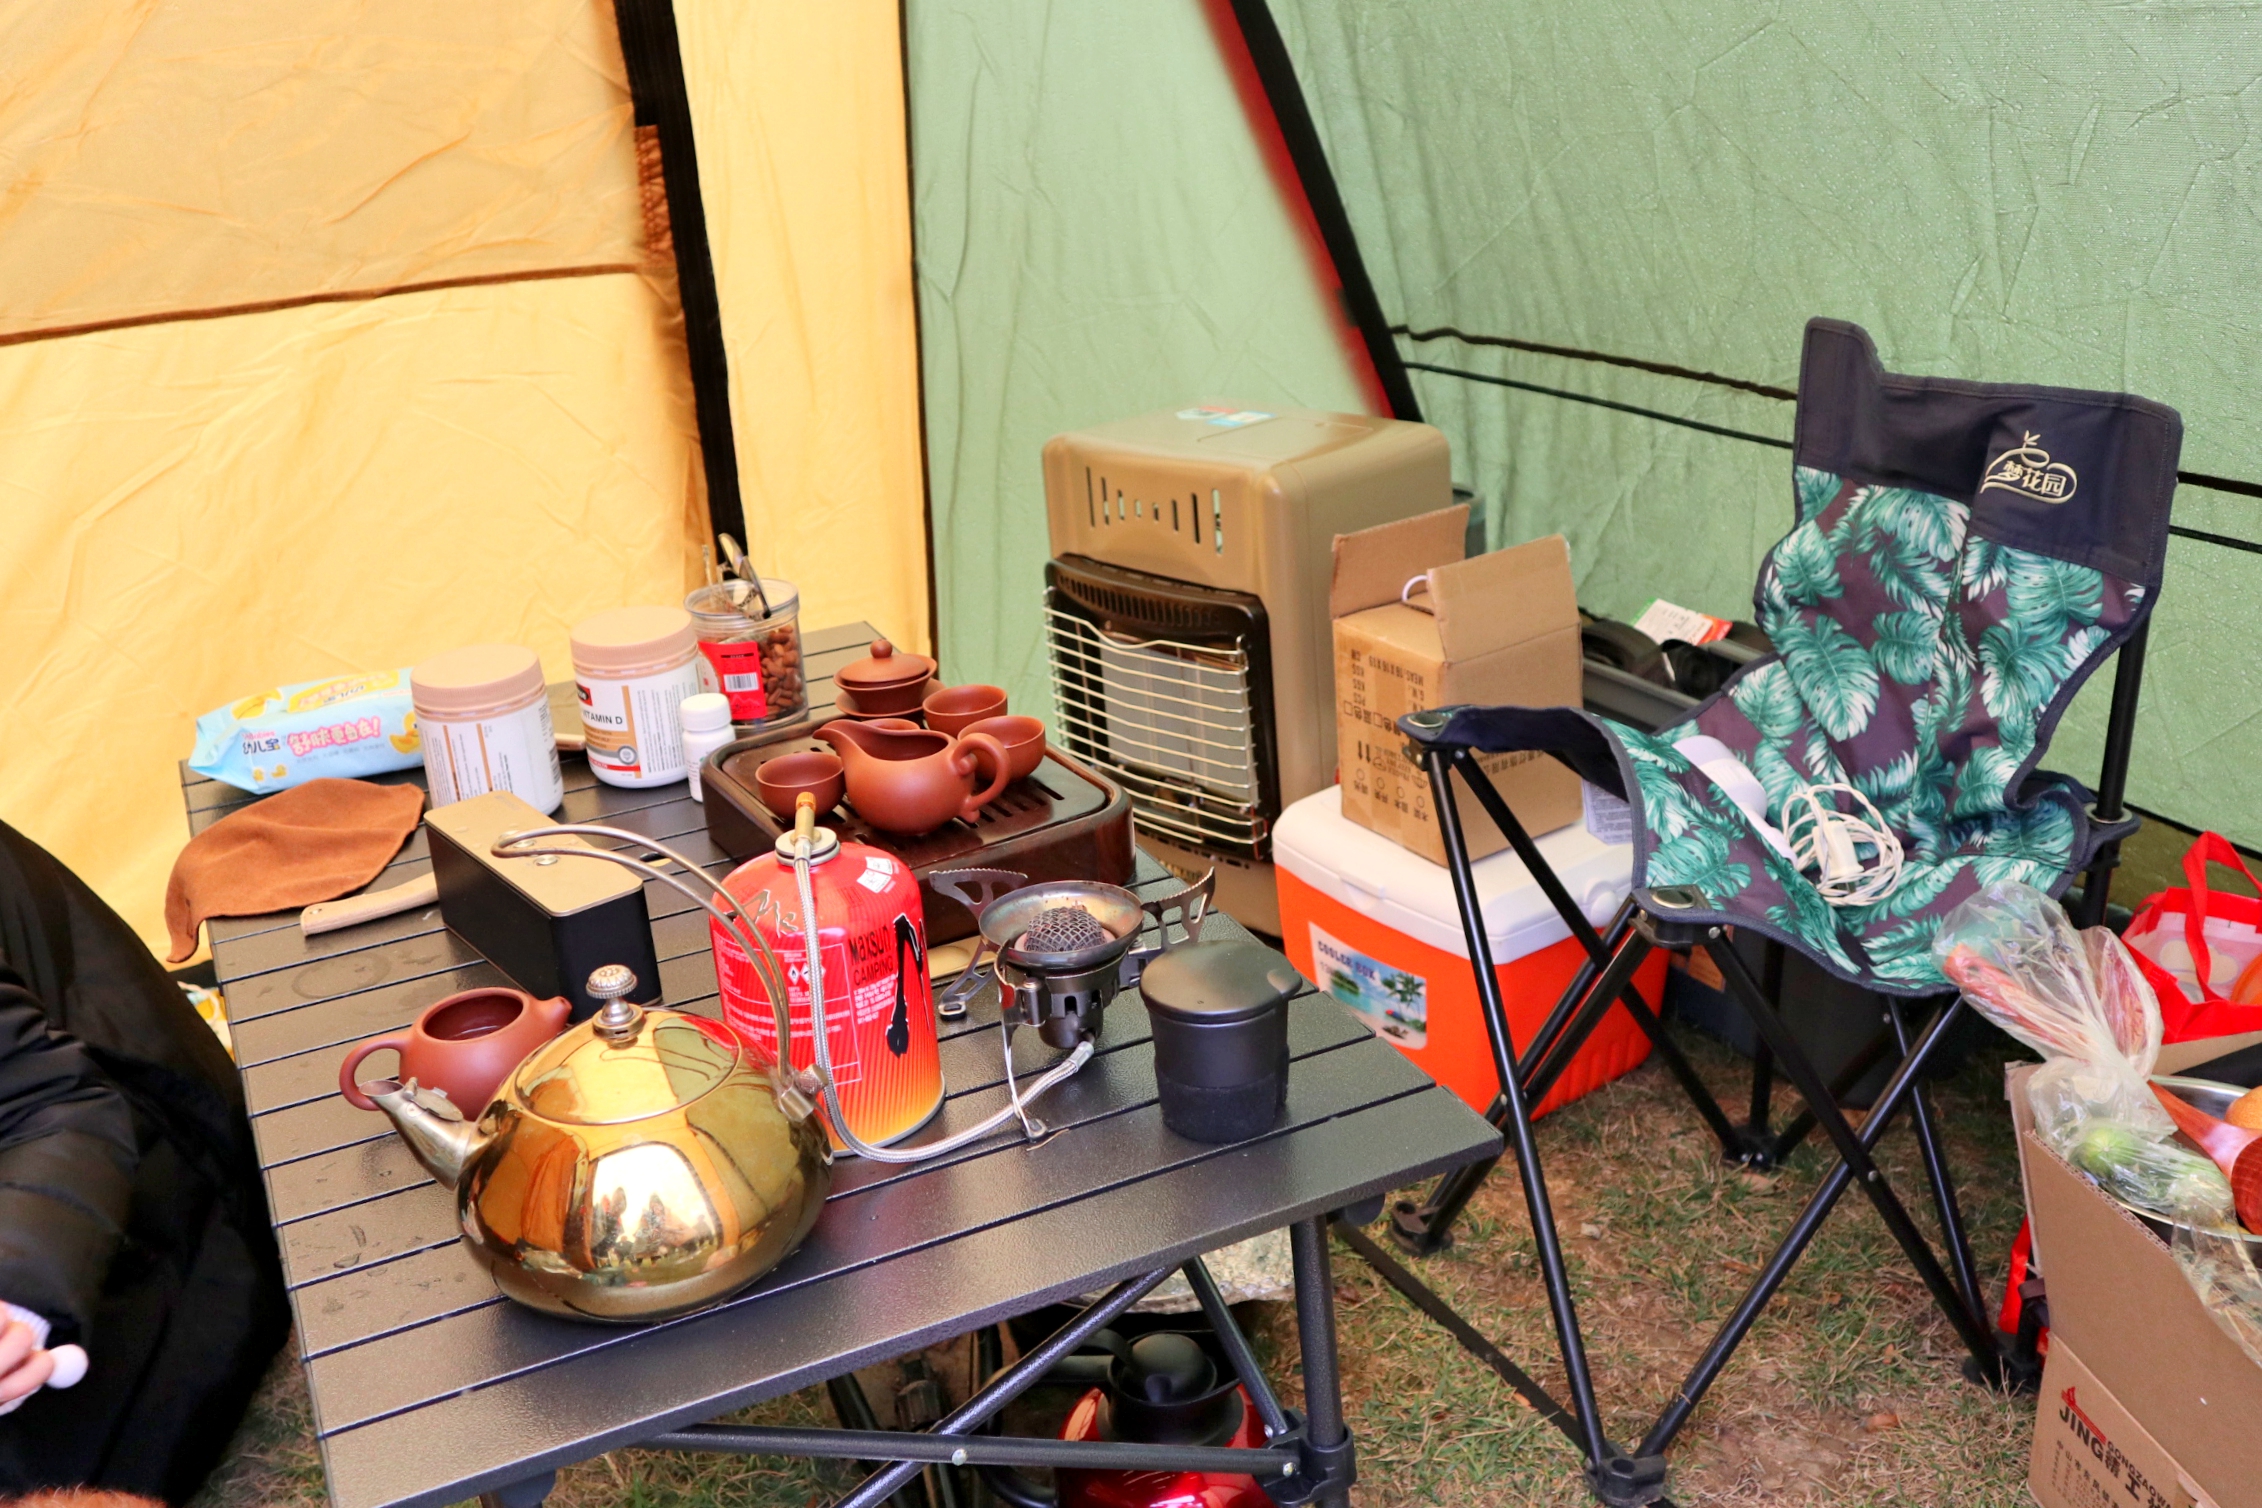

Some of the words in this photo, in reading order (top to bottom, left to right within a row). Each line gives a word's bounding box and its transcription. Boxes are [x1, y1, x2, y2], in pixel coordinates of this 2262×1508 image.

[1998, 460, 2067, 497] 梦花园
[1353, 680, 1365, 692] KGS
[1353, 693, 1366, 706] PCS
[615, 716, 623, 725] D
[853, 955, 894, 986] CAMPING
[1317, 940, 1353, 968] COOLER
[1355, 961, 1375, 980] BOX
[2059, 1405, 2104, 1462] JING
